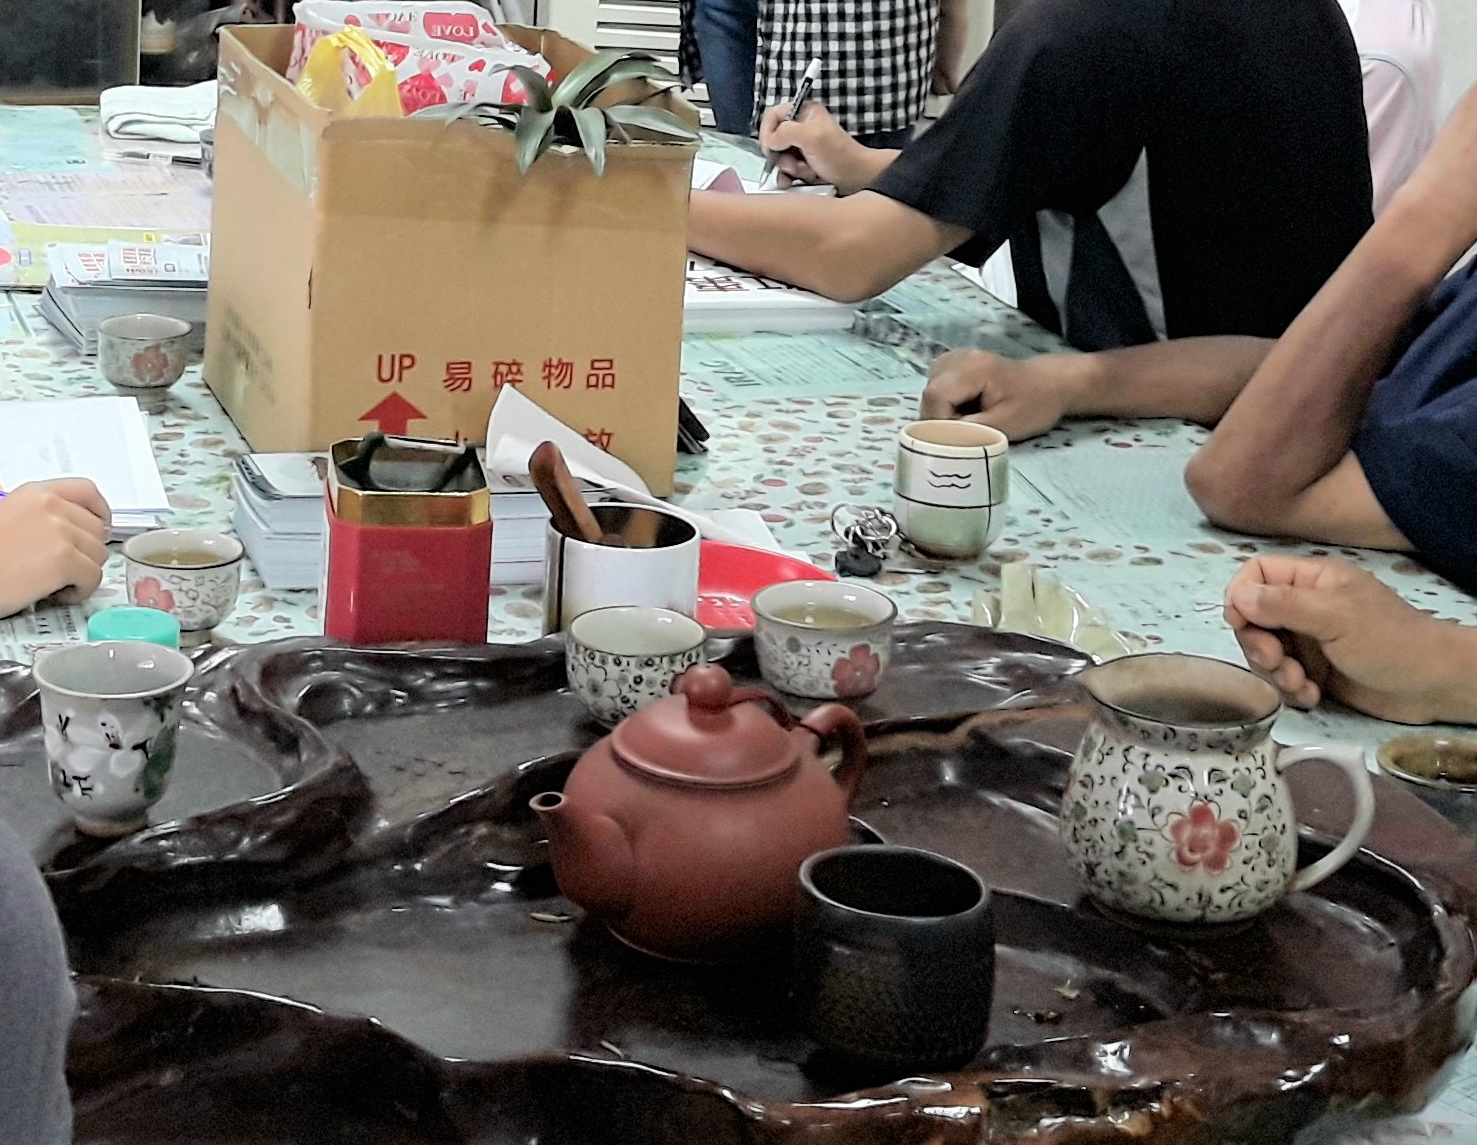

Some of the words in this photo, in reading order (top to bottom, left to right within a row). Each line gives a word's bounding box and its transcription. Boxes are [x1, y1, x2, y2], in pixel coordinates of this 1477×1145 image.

[376, 353, 416, 384] UP
[442, 357, 617, 392] 易碎物品
